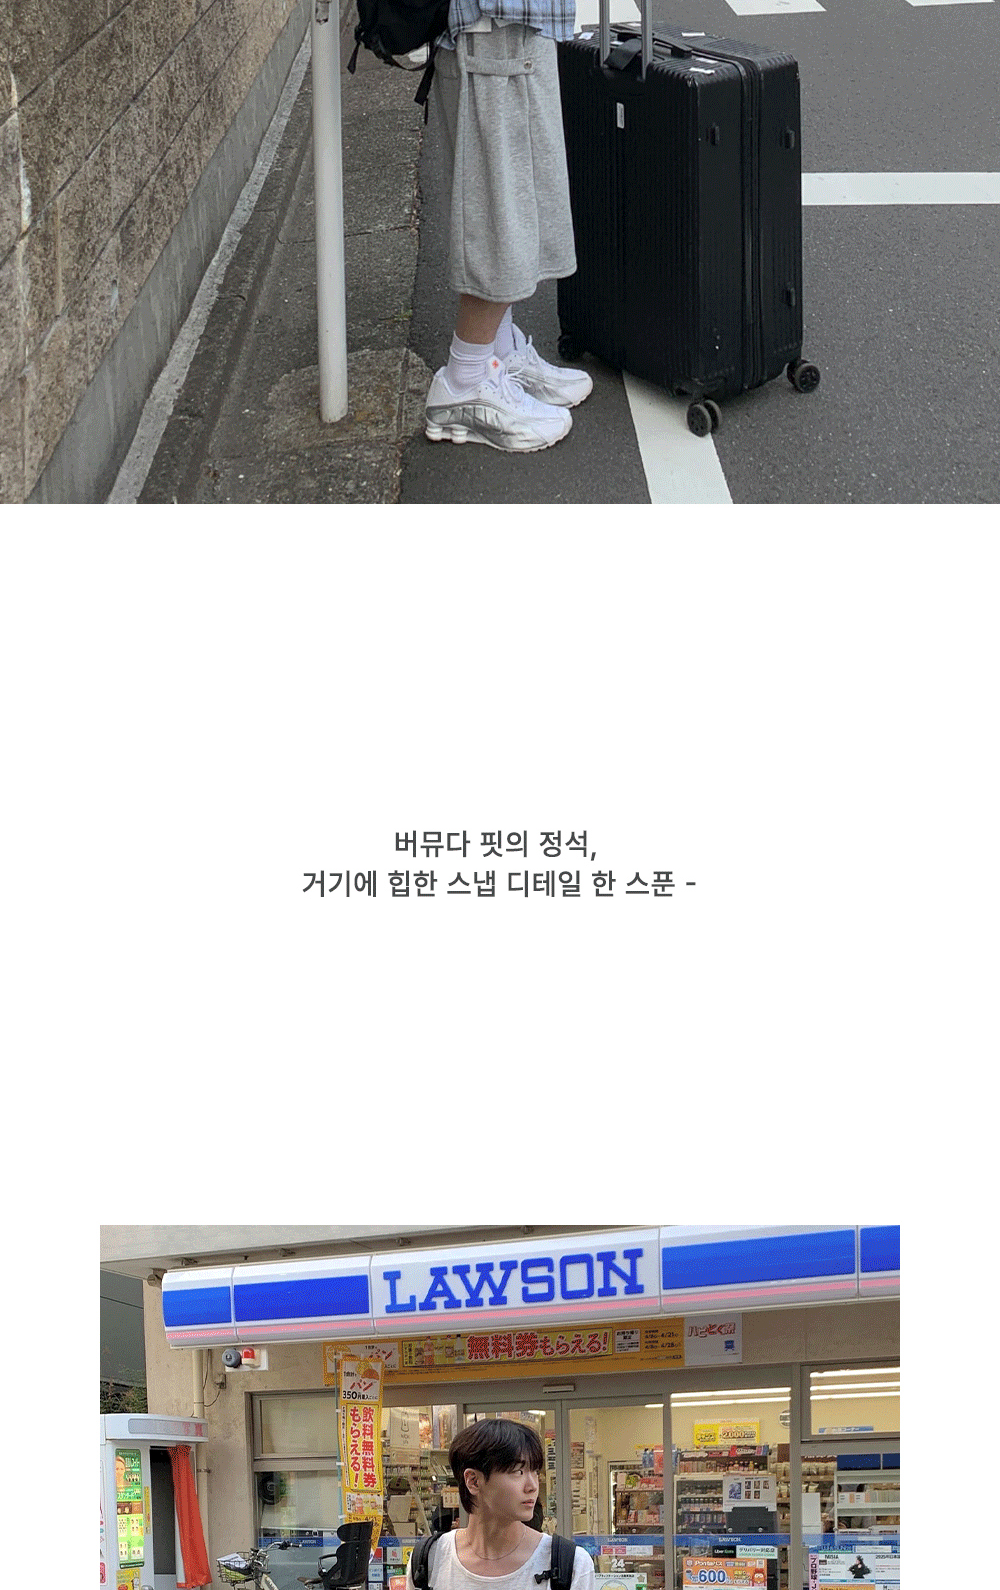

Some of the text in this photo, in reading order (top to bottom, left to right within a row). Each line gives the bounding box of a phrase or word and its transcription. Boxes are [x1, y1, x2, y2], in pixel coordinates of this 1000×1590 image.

[383, 1248, 645, 1314] LAWSON
[466, 1330, 609, 1362] 無料券もらえる!
[362, 1406, 377, 1488] 飲料無料券
[698, 1570, 726, 1583] 600
